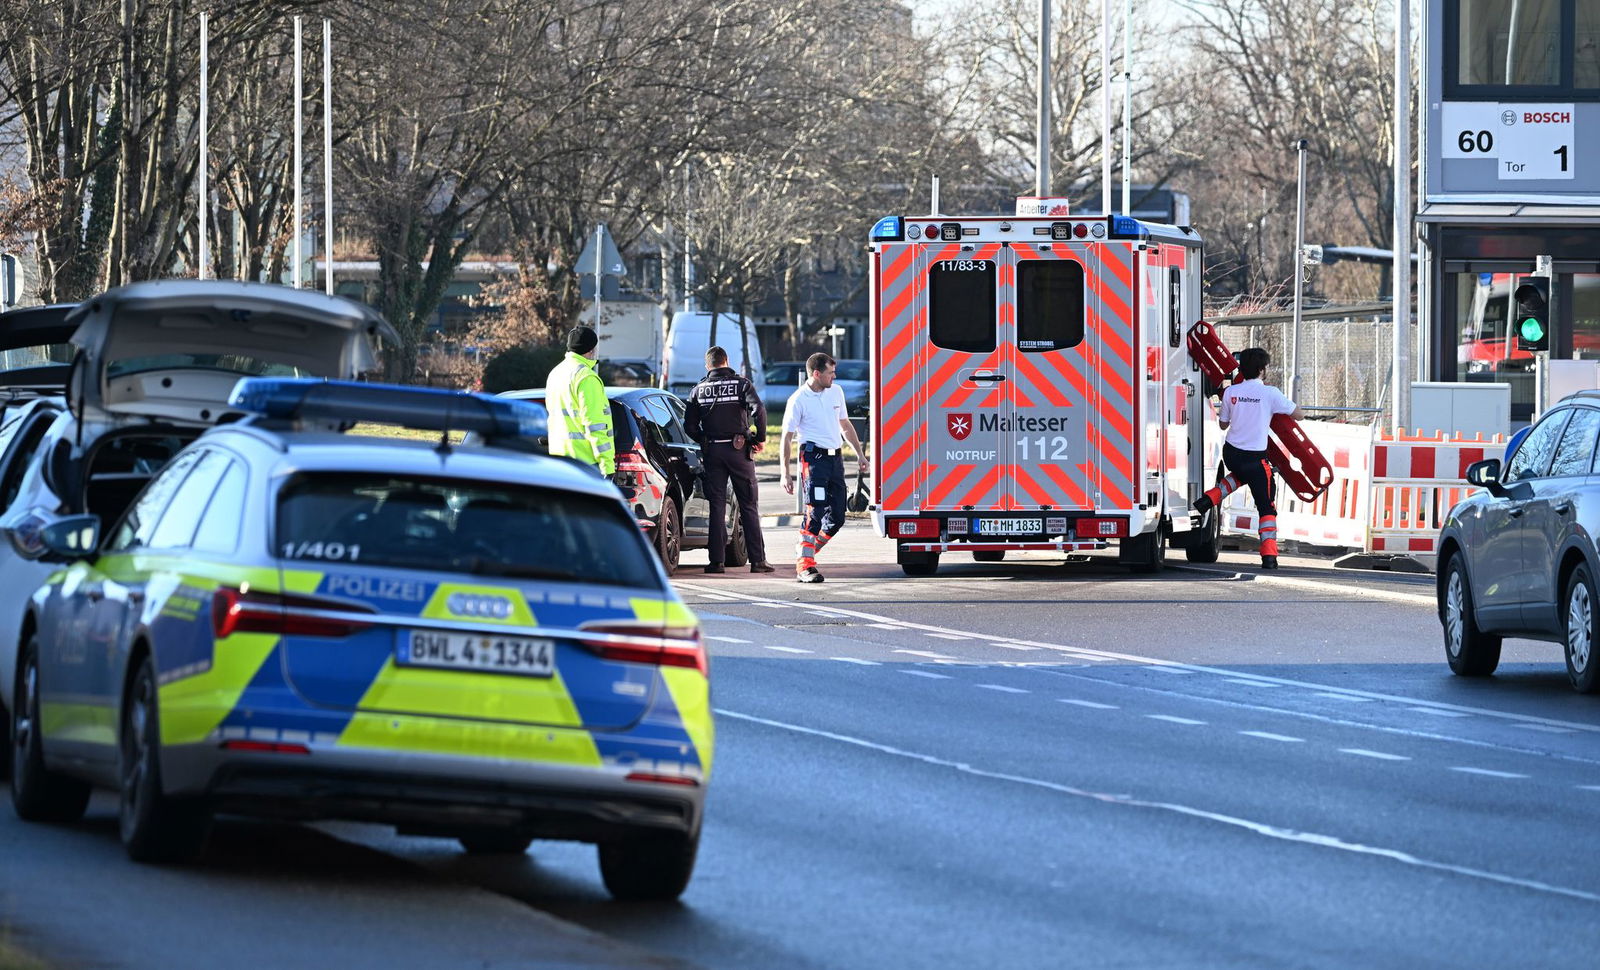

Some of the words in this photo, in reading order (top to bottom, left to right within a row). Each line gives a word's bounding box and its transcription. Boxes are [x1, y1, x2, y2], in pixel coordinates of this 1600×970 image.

[1523, 112, 1570, 123] BOSCH
[1458, 130, 1494, 153] 60
[1505, 161, 1526, 172] Tor
[1553, 145, 1568, 172] 1
[939, 260, 987, 272] 11/83-3
[698, 384, 738, 398] POLIZEI
[1238, 396, 1261, 404] Malteser
[979, 412, 1068, 432] Malteser
[945, 450, 996, 461] NOTRUF
[1016, 436, 1068, 461] 112
[980, 519, 993, 531] RT
[1000, 519, 1014, 531] MH
[1016, 519, 1041, 531] 1833
[281, 542, 361, 561] 1/401
[327, 575, 425, 601] POLIZEI
[411, 634, 457, 663] BWL
[463, 641, 476, 663] 4
[494, 641, 551, 670] 1344
